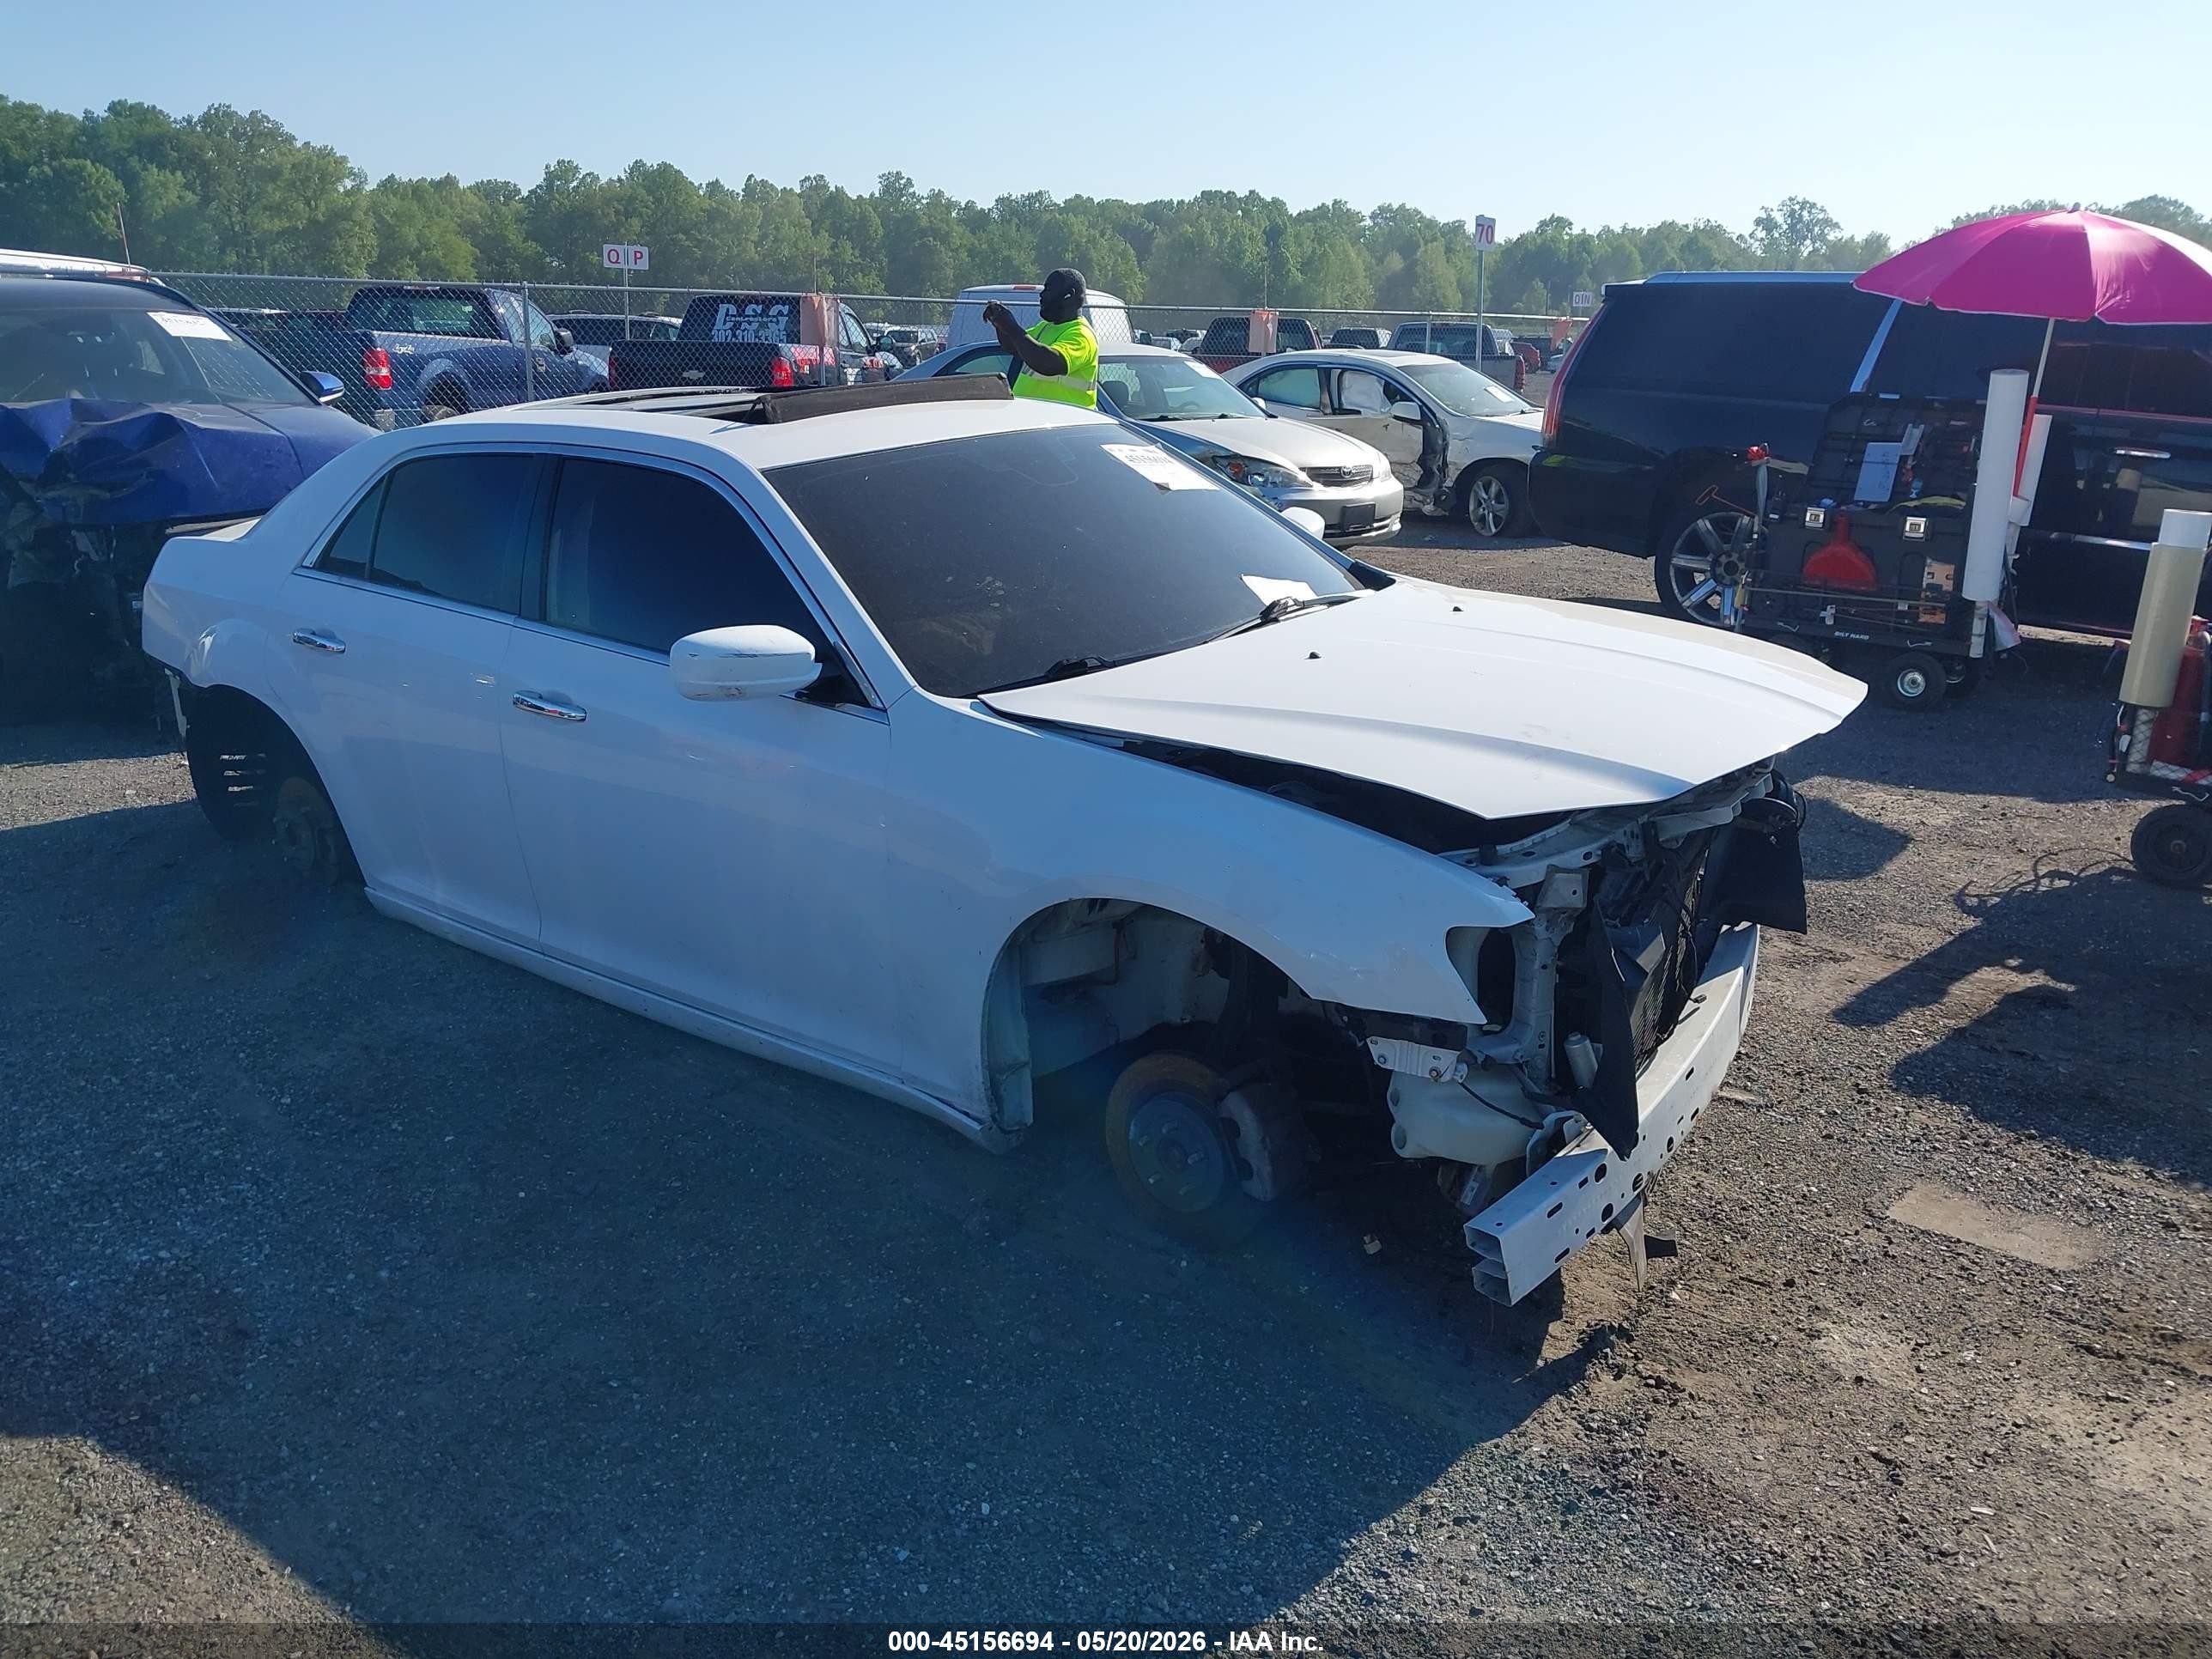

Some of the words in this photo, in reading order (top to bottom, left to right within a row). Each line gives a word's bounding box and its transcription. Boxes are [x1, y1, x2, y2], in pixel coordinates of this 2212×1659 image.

[1477, 223, 1494, 245] 70
[607, 249, 621, 264] Q
[634, 250, 644, 265] P
